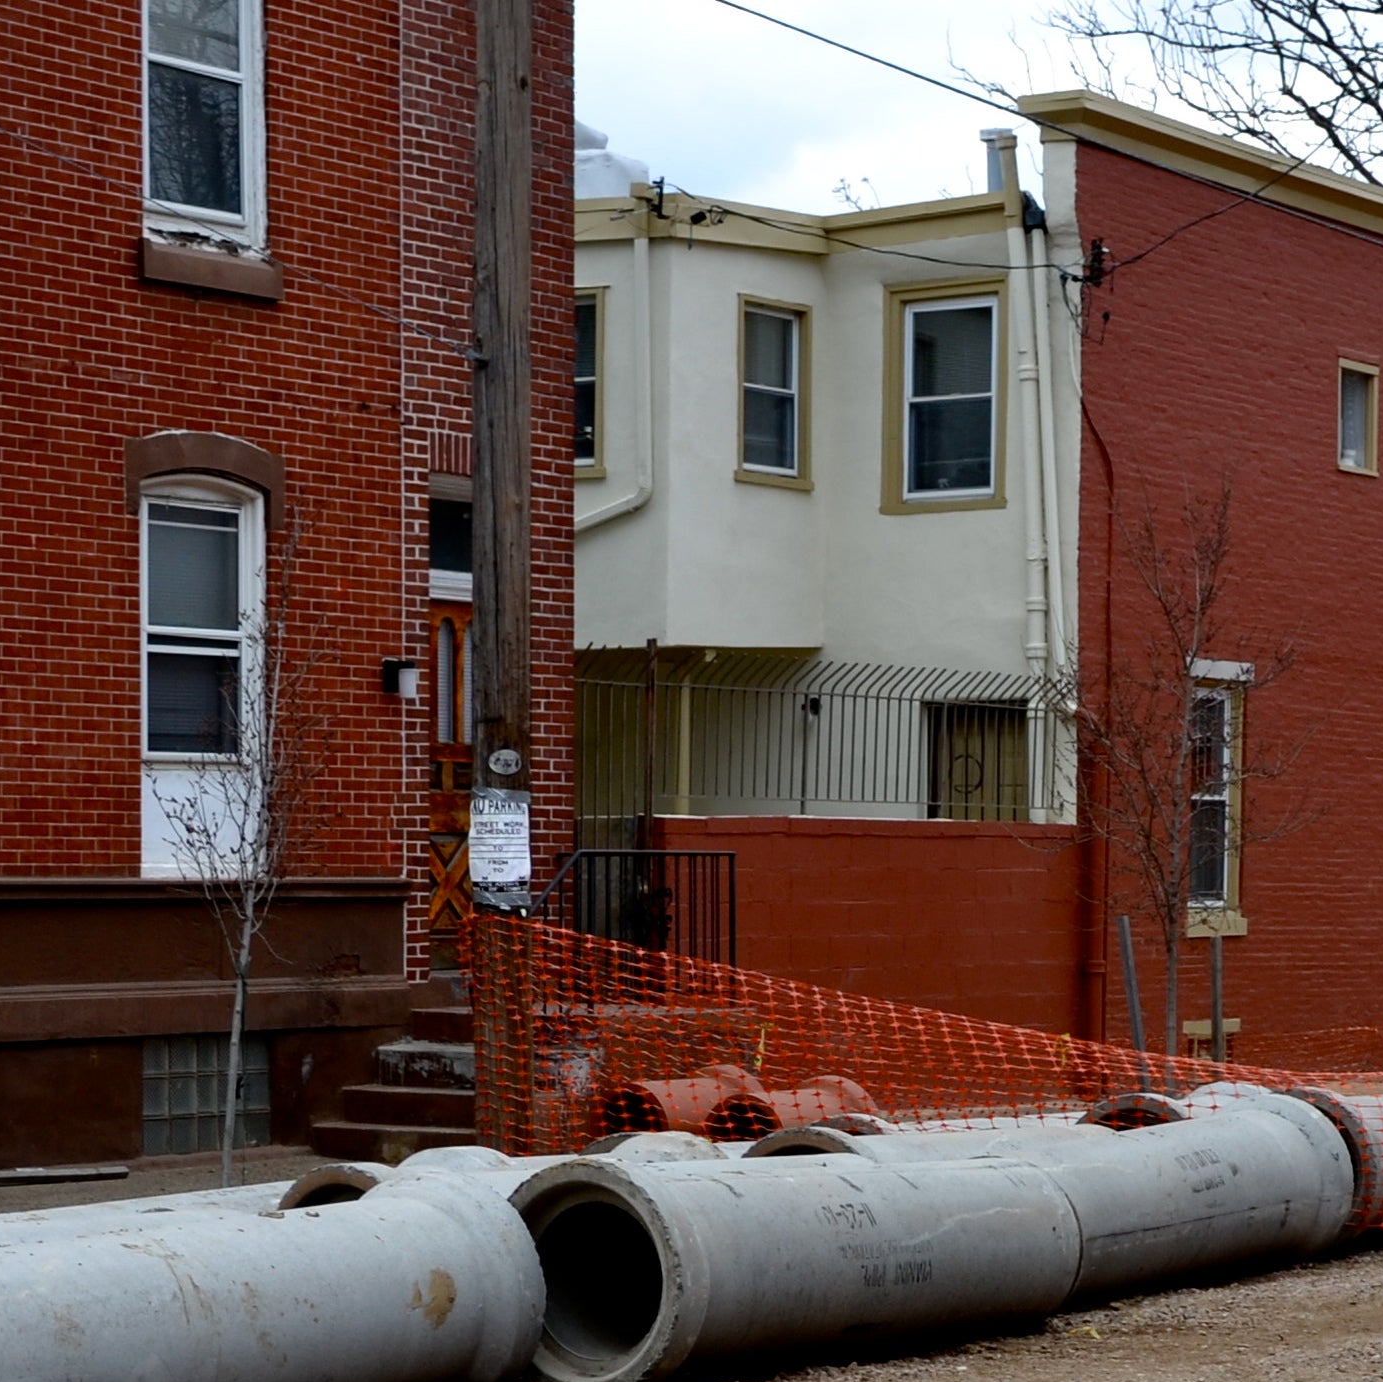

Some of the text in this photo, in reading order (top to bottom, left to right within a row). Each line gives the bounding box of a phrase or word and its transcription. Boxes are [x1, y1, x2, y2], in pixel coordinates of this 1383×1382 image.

[472, 798, 485, 814] NO
[474, 821, 499, 829] STREET
[475, 828, 522, 836] SCHEDULED
